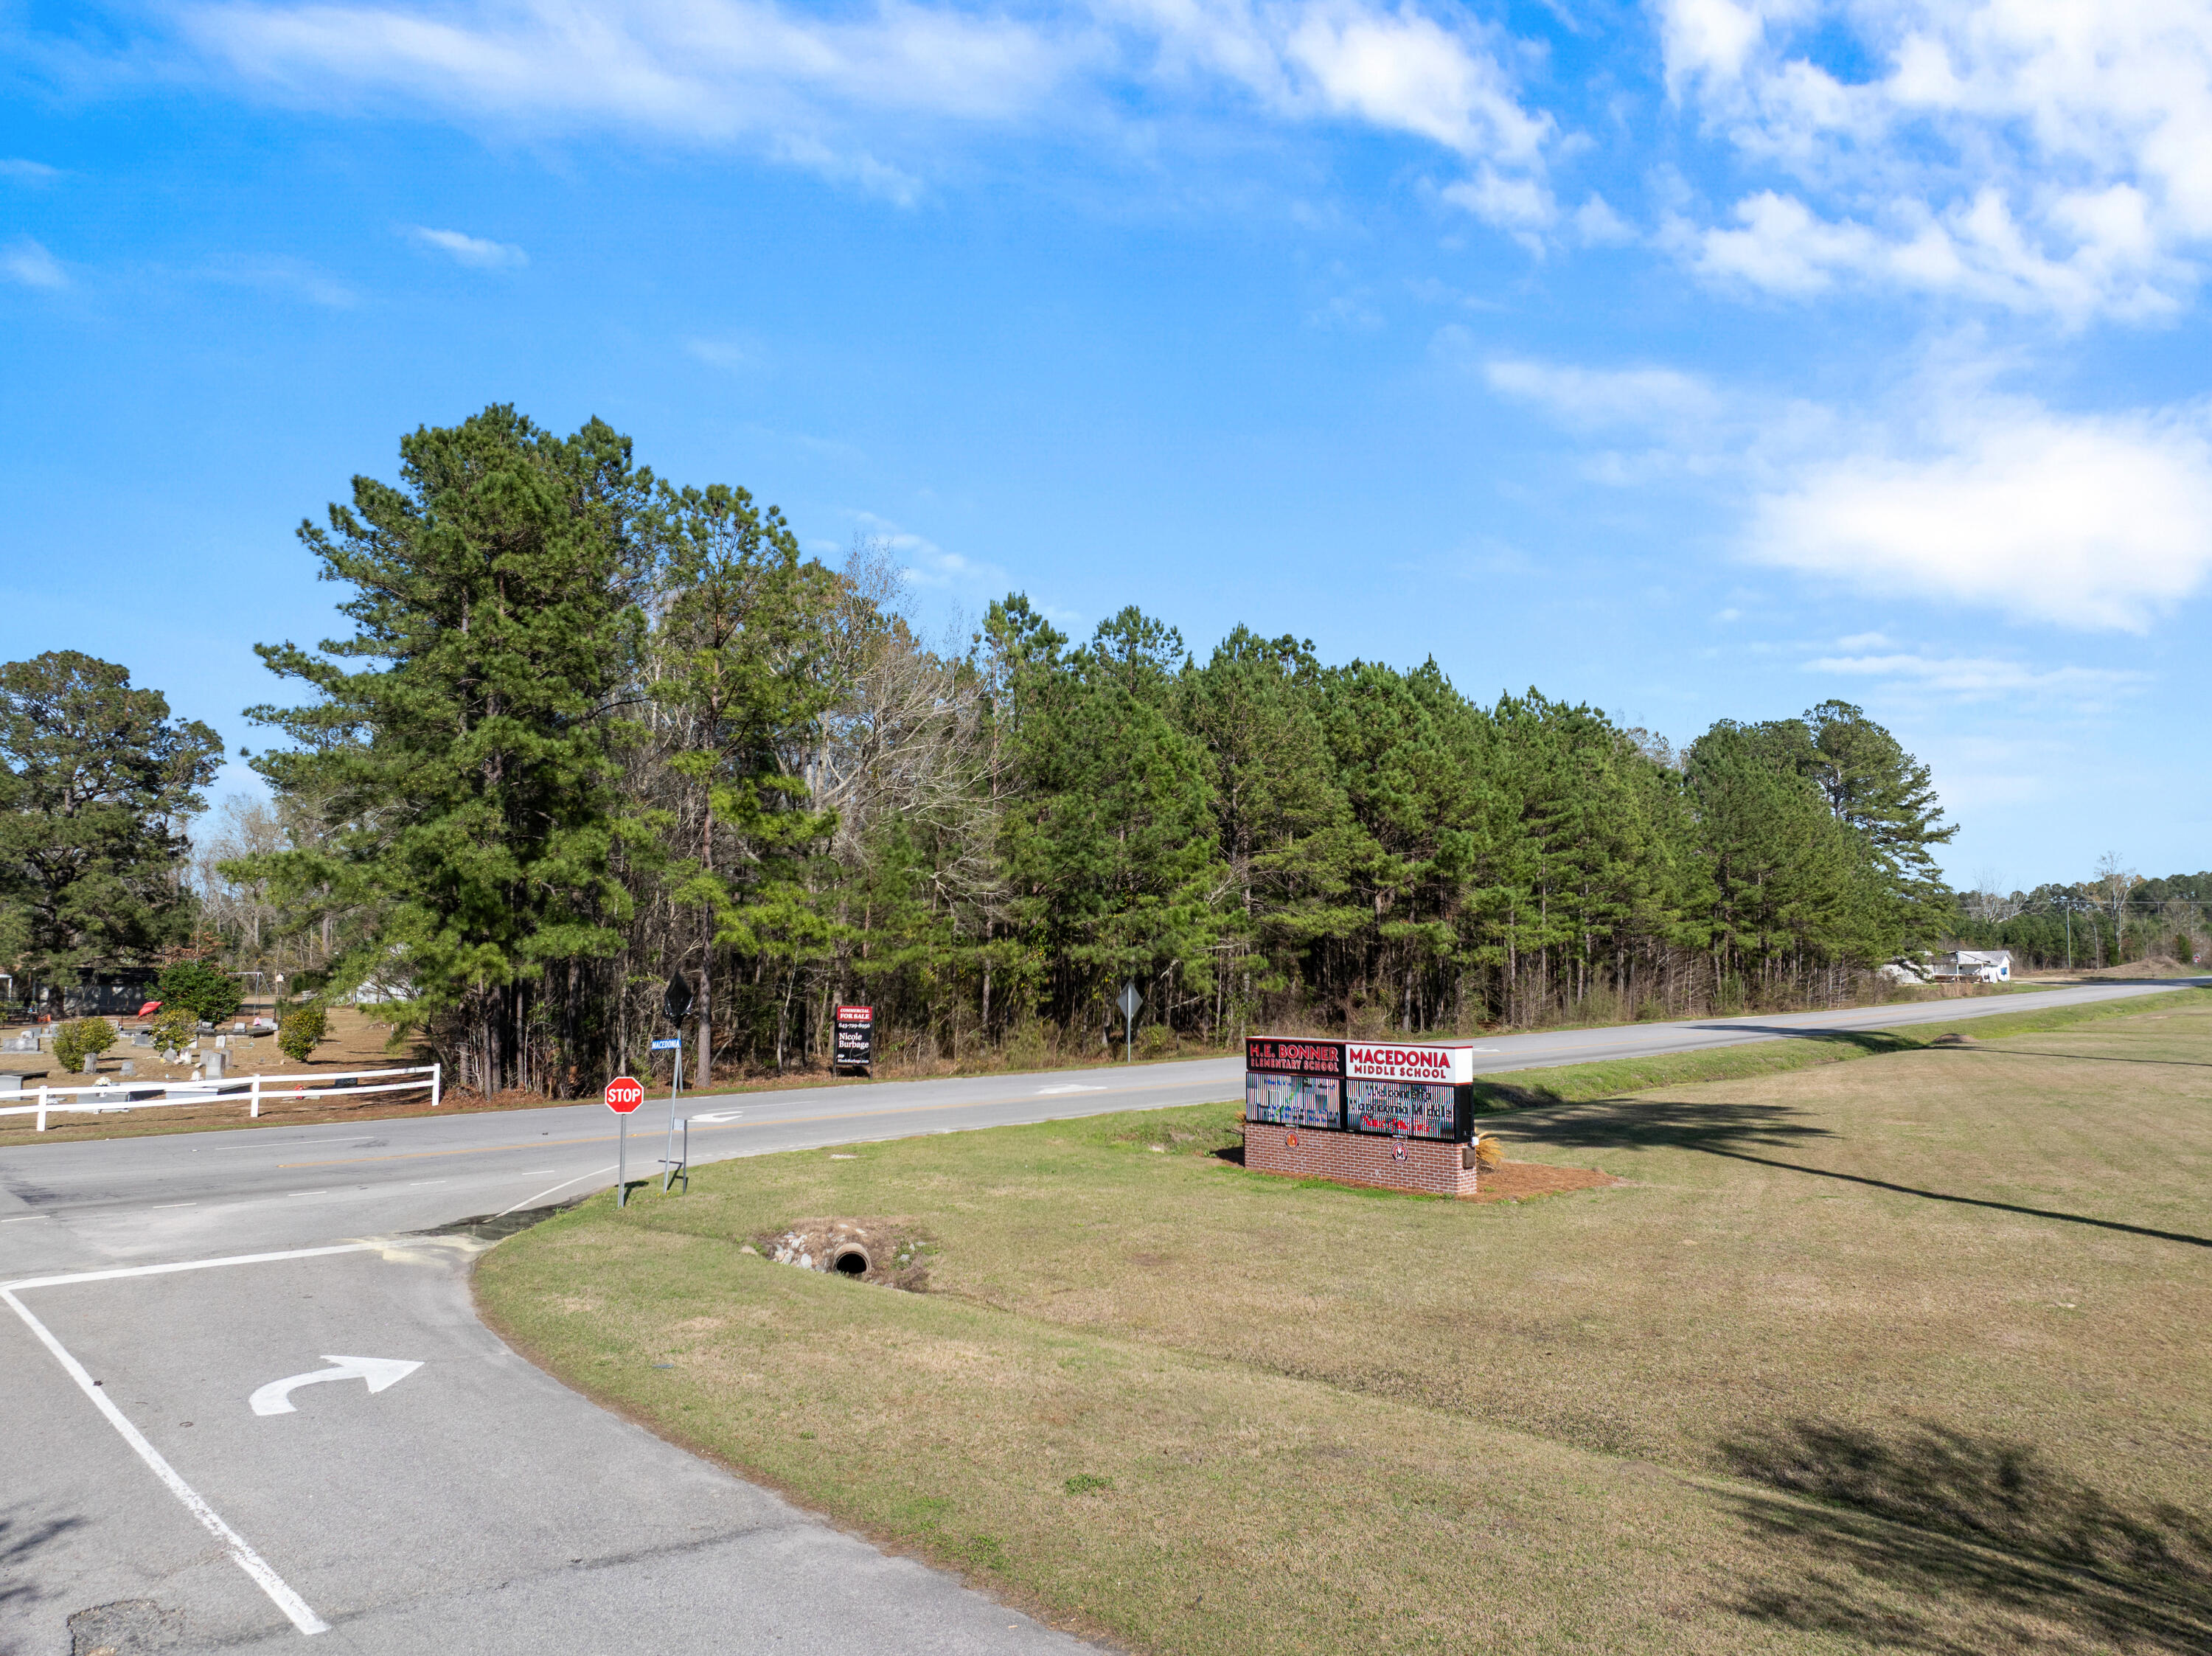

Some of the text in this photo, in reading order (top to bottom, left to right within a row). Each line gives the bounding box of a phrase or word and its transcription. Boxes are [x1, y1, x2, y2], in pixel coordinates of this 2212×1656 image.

[838, 1032, 863, 1040] Nicole
[652, 1039, 680, 1049] MACEDONIA
[838, 1040, 869, 1050] Burbage
[1250, 1043, 1340, 1062] H.E. BONNER
[1349, 1048, 1451, 1068] MACEDONIA
[1251, 1058, 1339, 1072] ELEMENTARY SCHOOL
[1354, 1064, 1447, 1079] MIDDLE SCHOOL
[608, 1088, 641, 1103] STOP
